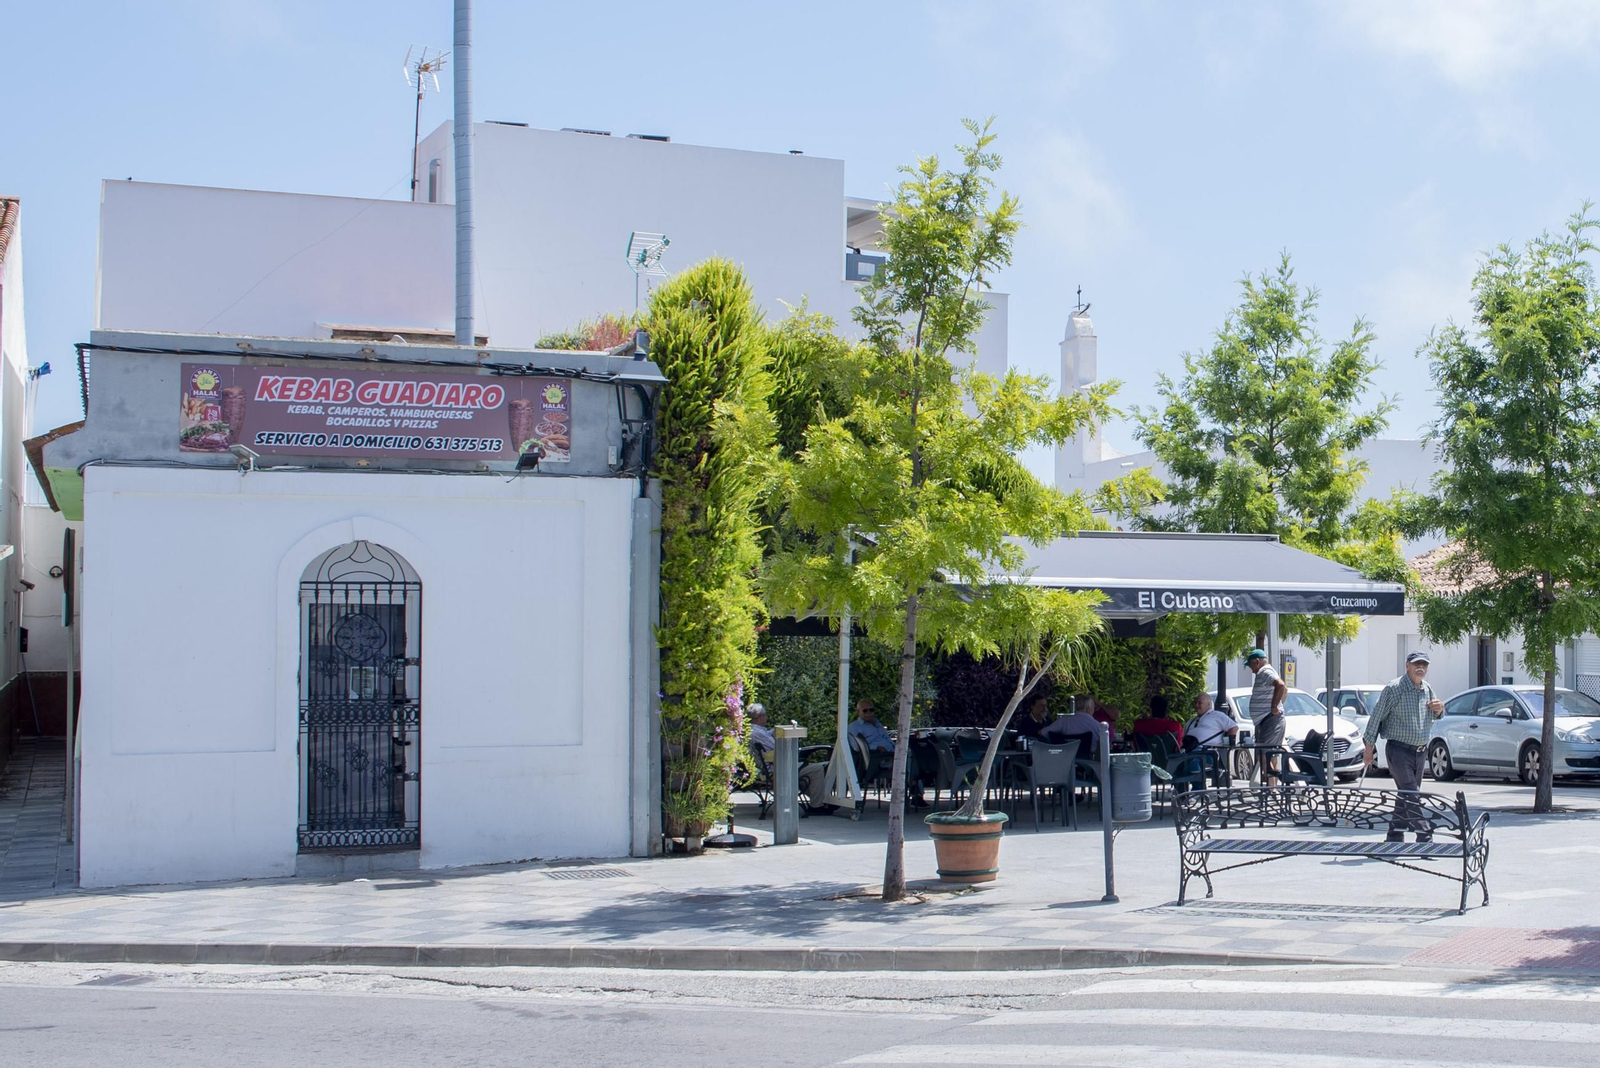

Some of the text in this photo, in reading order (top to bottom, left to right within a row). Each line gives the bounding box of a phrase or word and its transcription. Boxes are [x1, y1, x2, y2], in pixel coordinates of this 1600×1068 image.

[255, 375, 505, 409] KEBAB GUADIARO
[390, 408, 474, 419] HAMBURGUESAS
[325, 417, 439, 429] BOCADILLOS Y PIZZAS
[254, 431, 504, 452] SERVICIO A DOMICILIO 631 375 513
[1138, 591, 1234, 608] El Cubano
[1330, 595, 1378, 609] Cruzcampo
